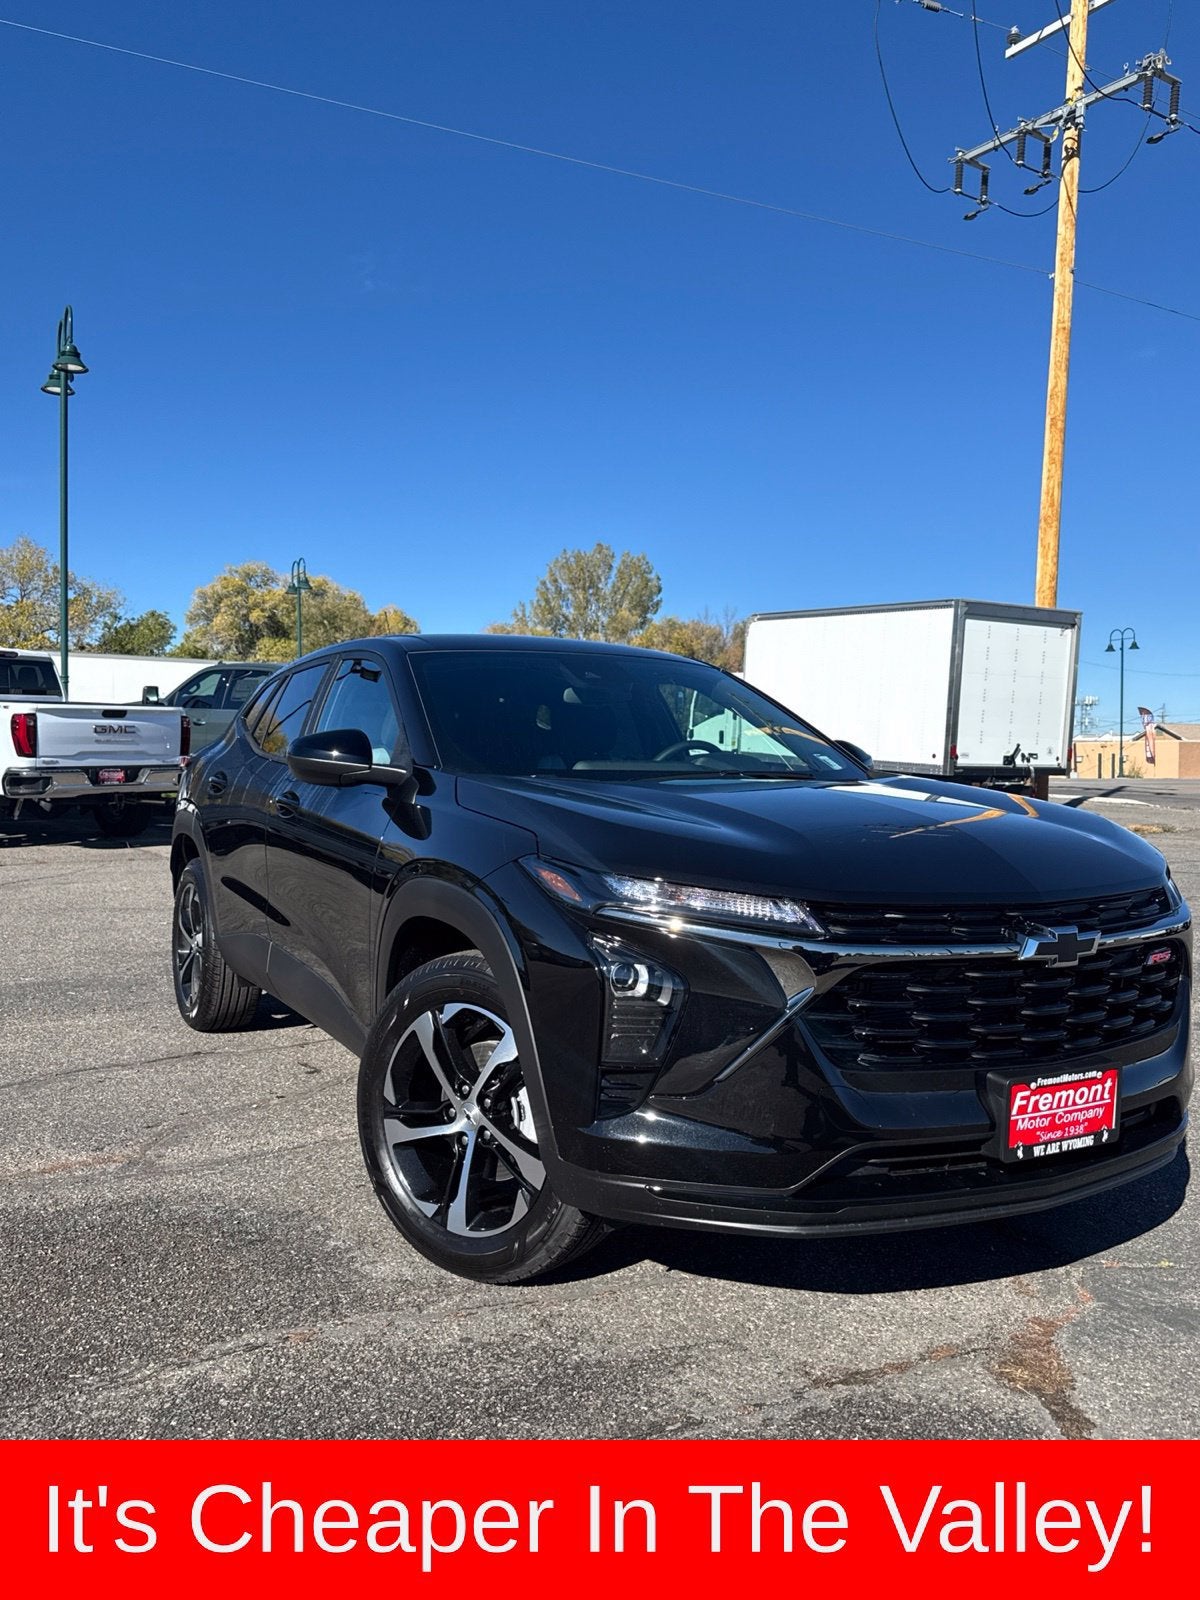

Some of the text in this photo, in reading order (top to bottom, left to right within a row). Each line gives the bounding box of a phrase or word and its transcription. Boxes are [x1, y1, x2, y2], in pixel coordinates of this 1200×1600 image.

[93, 724, 137, 734] GMC
[1150, 950, 1172, 965] RS
[1036, 1070, 1098, 1087] FremontMotors.com
[1011, 1078, 1113, 1116] Fremont
[1016, 1106, 1105, 1131] Motor Company
[1033, 1135, 1095, 1158] WE ARE WYOMING
